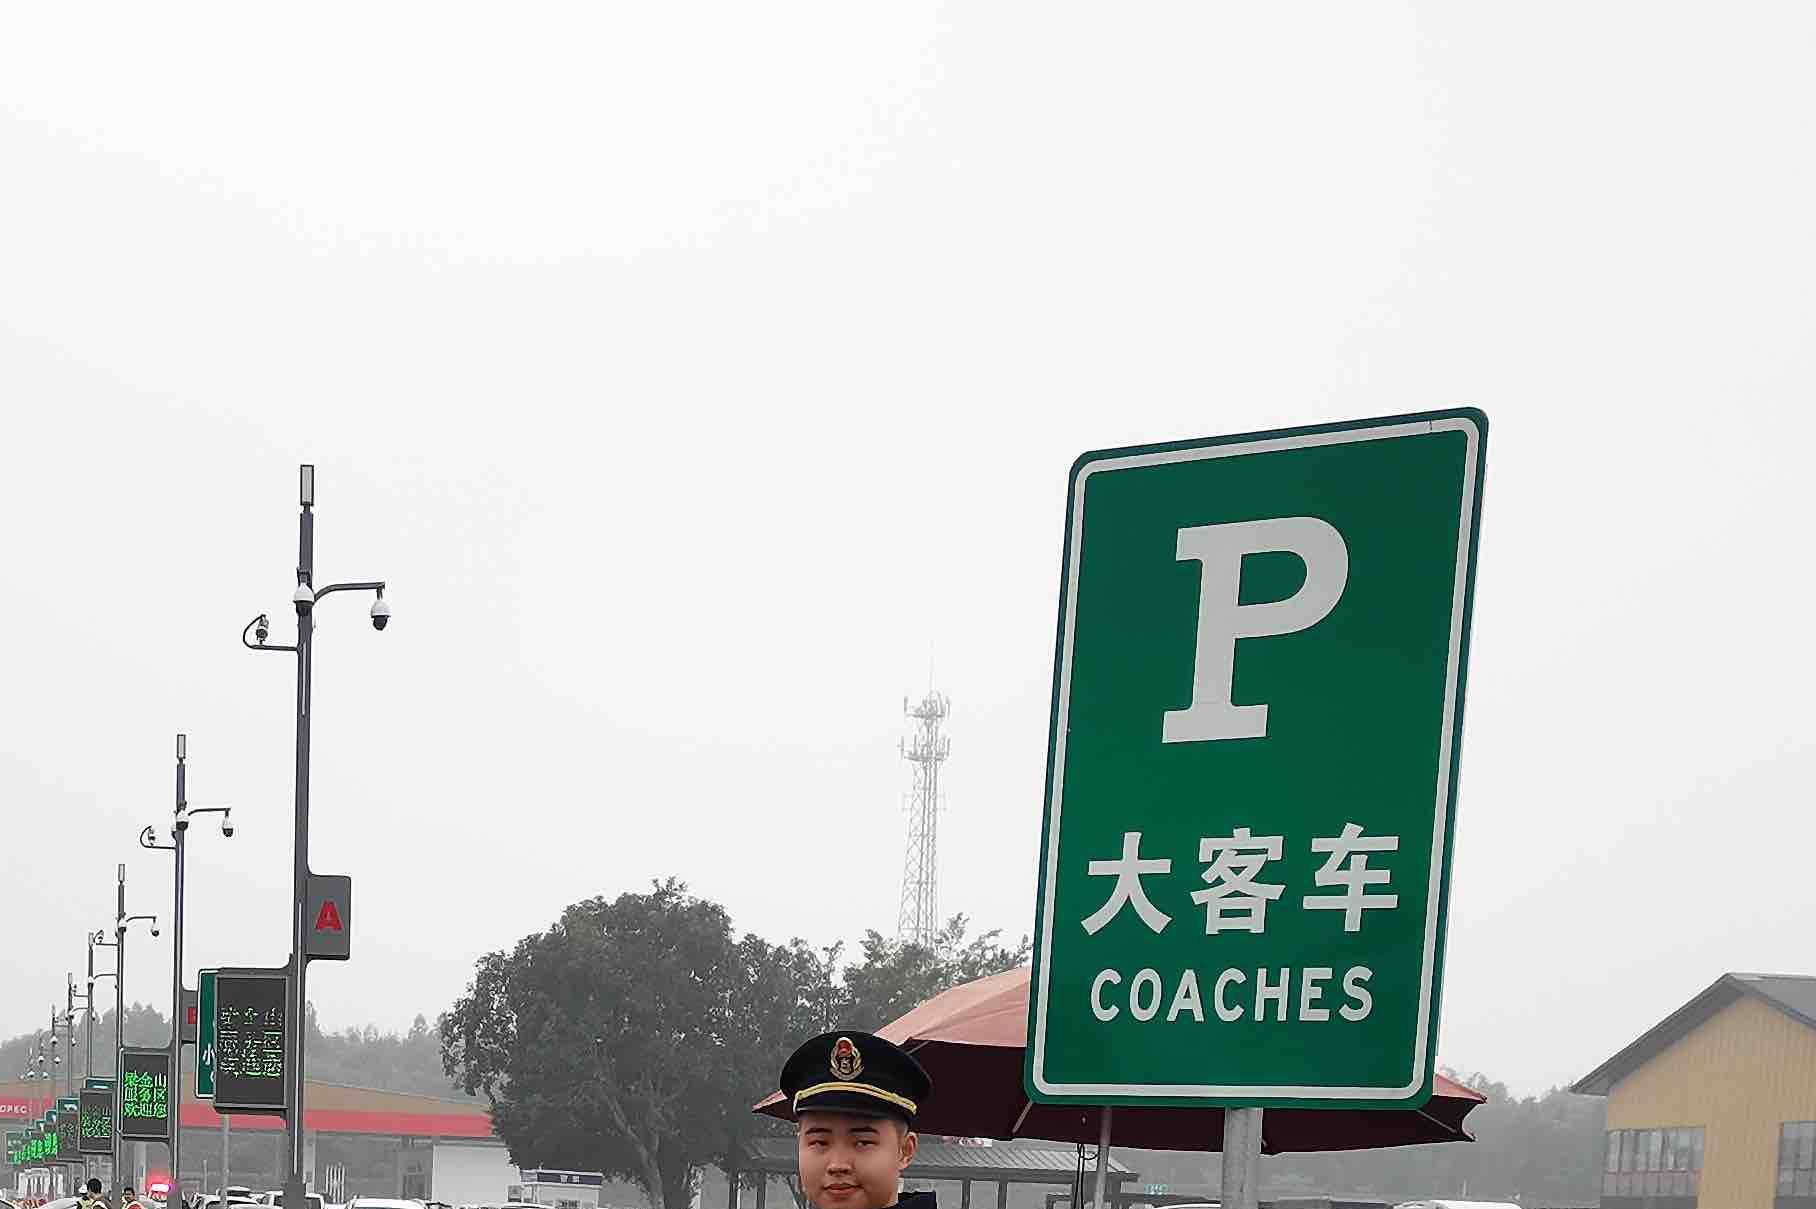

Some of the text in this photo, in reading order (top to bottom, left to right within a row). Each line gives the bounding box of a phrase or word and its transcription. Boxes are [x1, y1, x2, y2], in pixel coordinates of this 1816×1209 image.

[1162, 515, 1349, 744] P
[315, 899, 341, 930] A
[1080, 822, 1400, 936] 大客车
[1090, 966, 1374, 1024] COACHES
